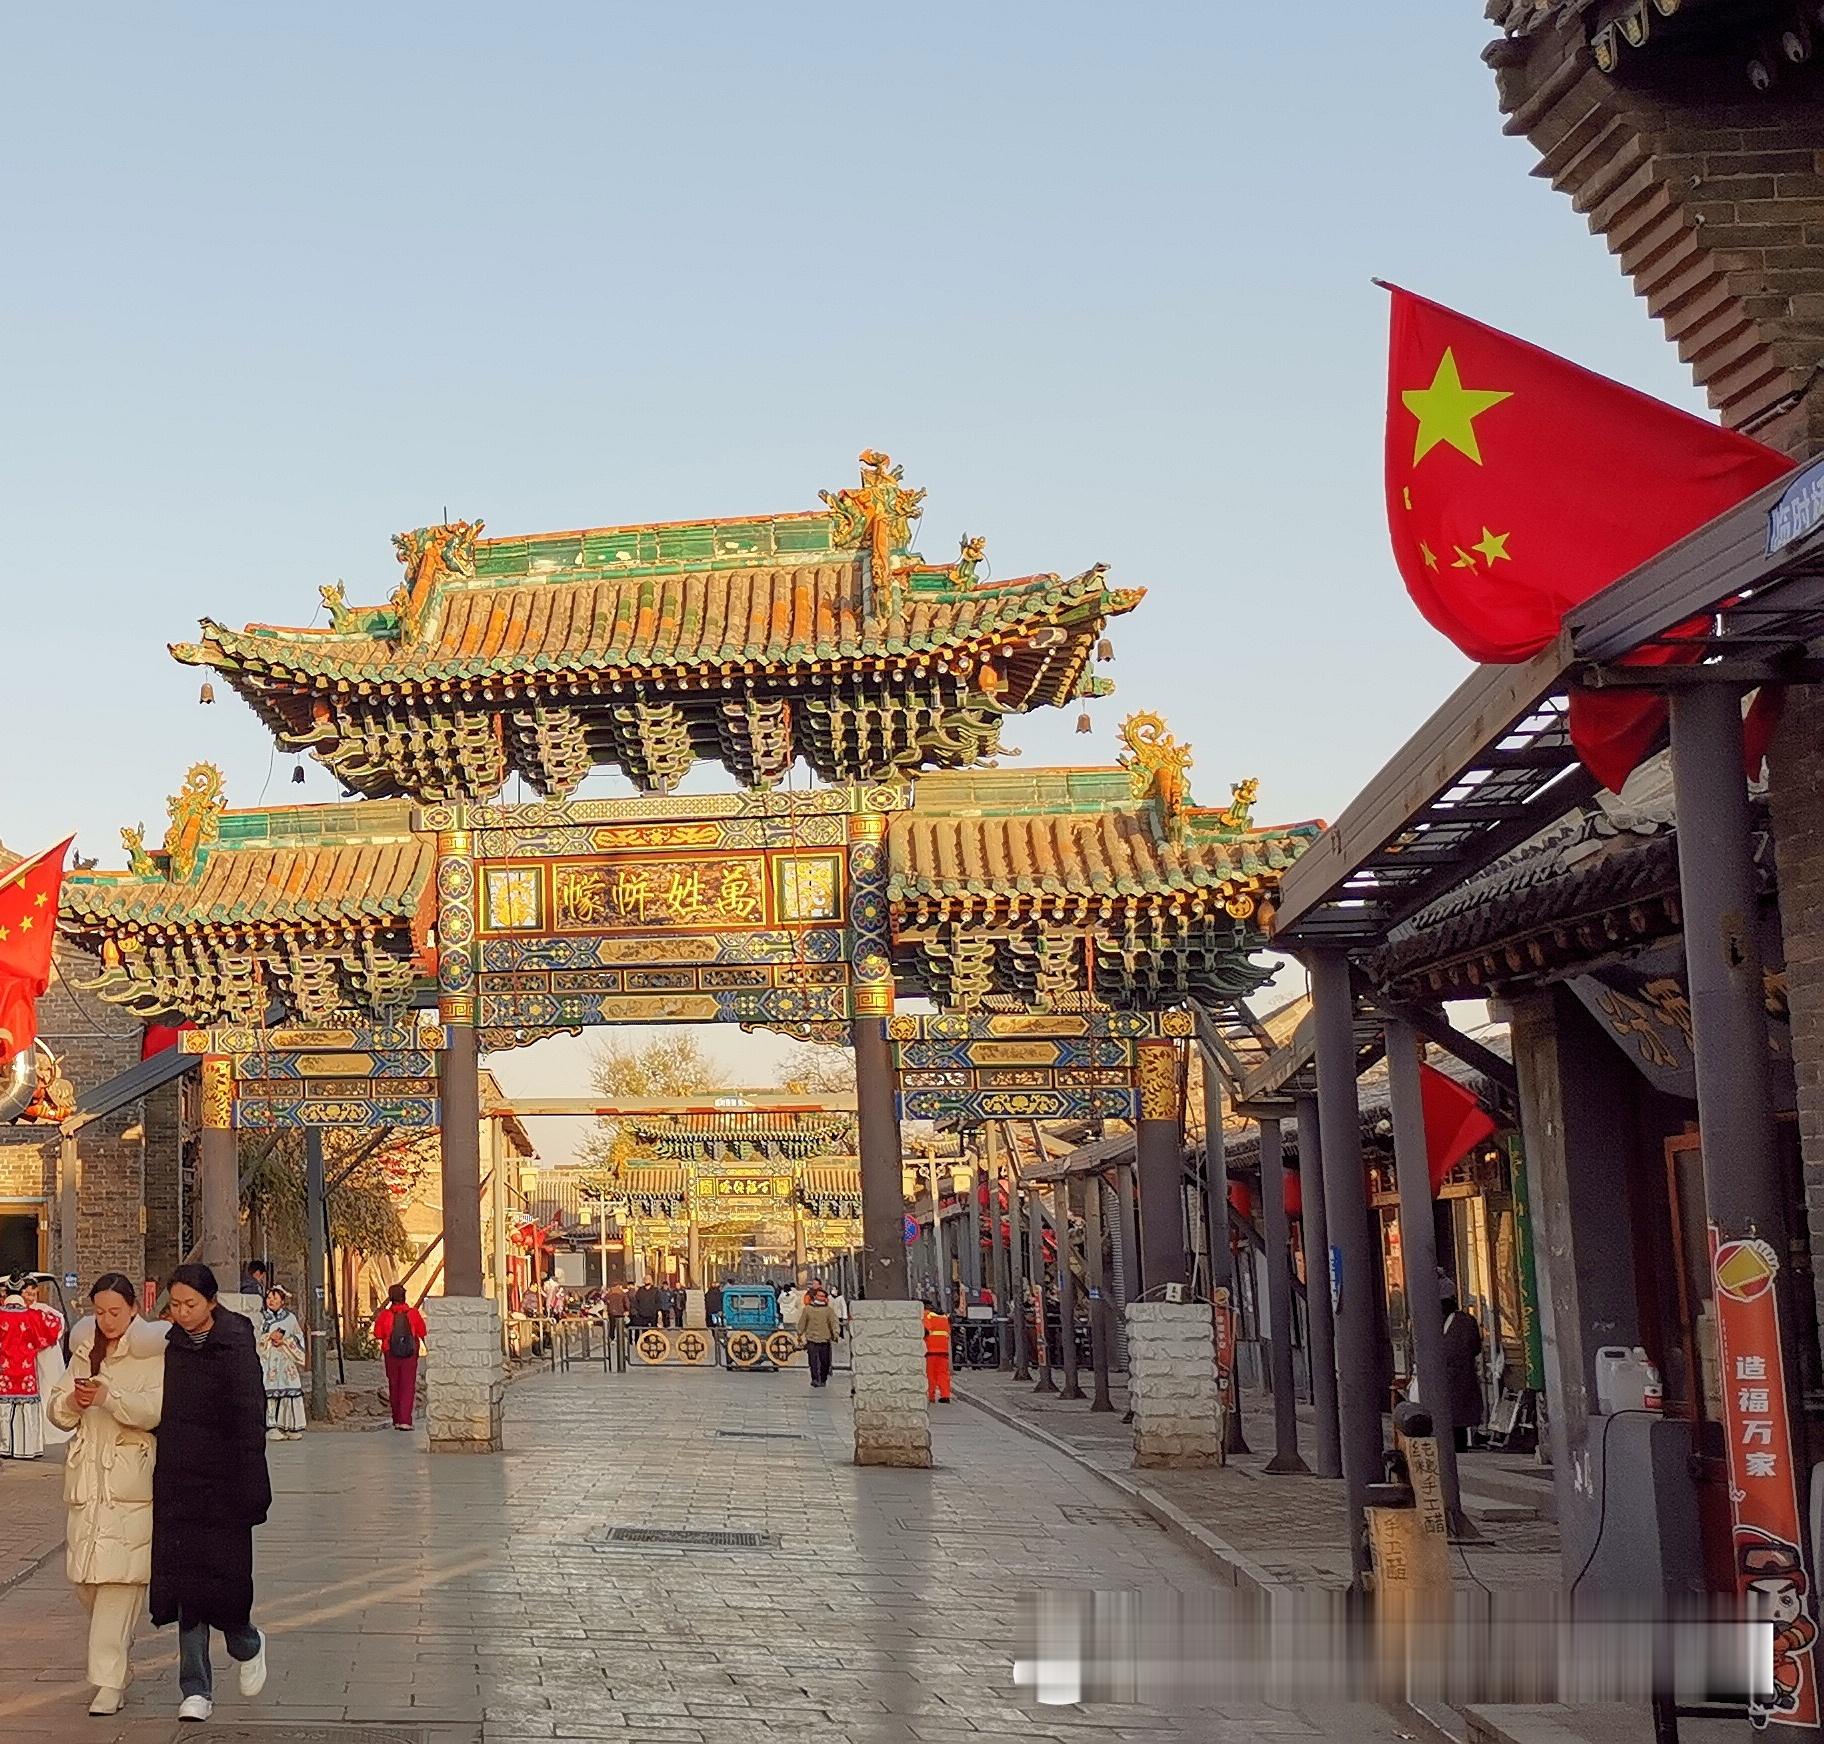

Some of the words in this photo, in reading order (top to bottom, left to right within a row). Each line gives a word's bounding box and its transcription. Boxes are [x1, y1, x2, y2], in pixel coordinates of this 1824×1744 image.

[1735, 1356, 1777, 1477] 造福万家
[1384, 1514, 1408, 1581] 手工醋
